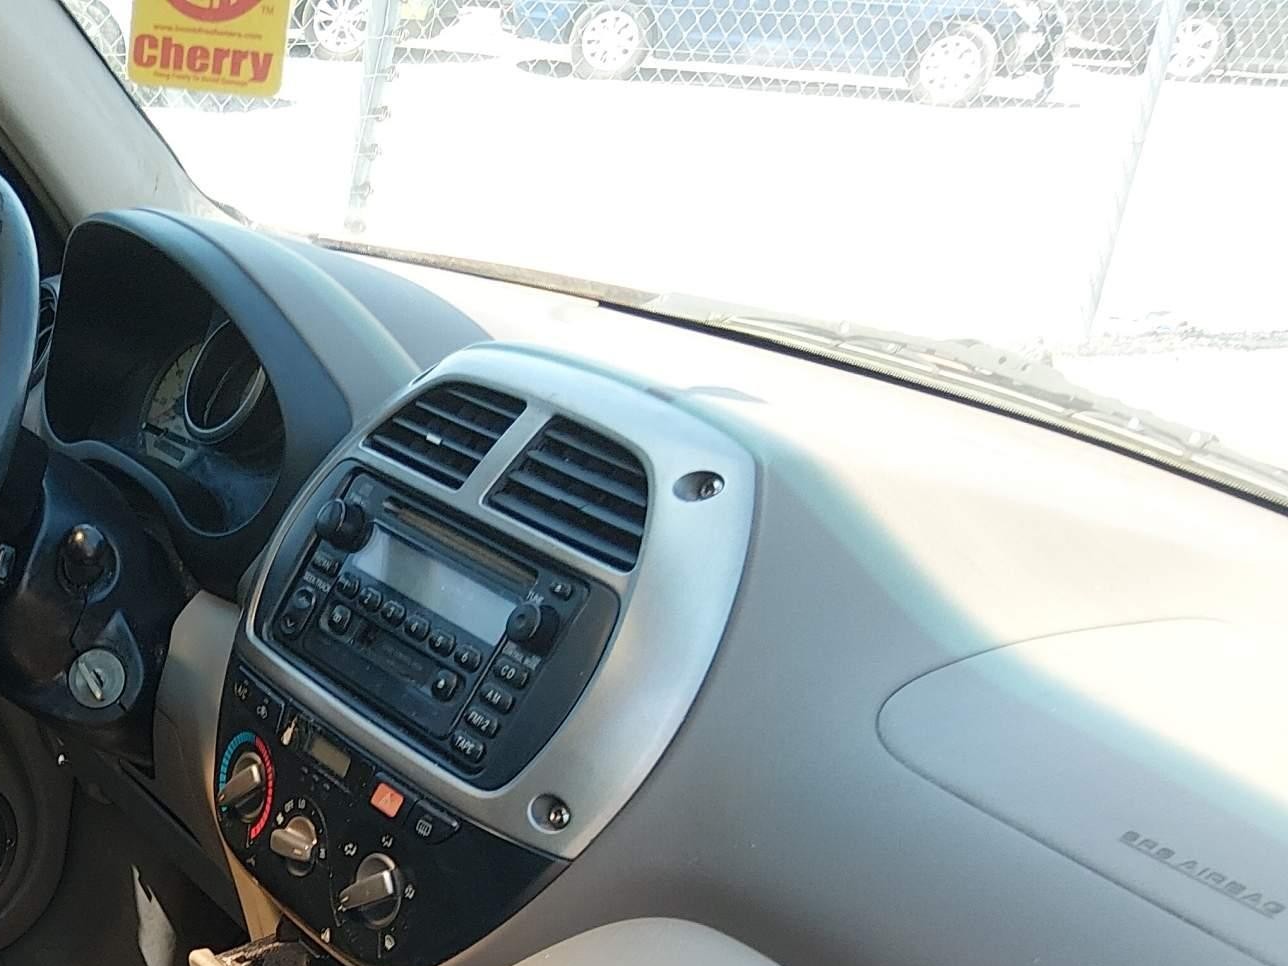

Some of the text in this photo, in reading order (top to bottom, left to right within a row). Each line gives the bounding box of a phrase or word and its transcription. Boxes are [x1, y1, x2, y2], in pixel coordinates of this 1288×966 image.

[133, 34, 274, 82] Cherry
[500, 664, 516, 680] CD
[485, 689, 501, 705] AM
[454, 735, 476, 754] TAPE
